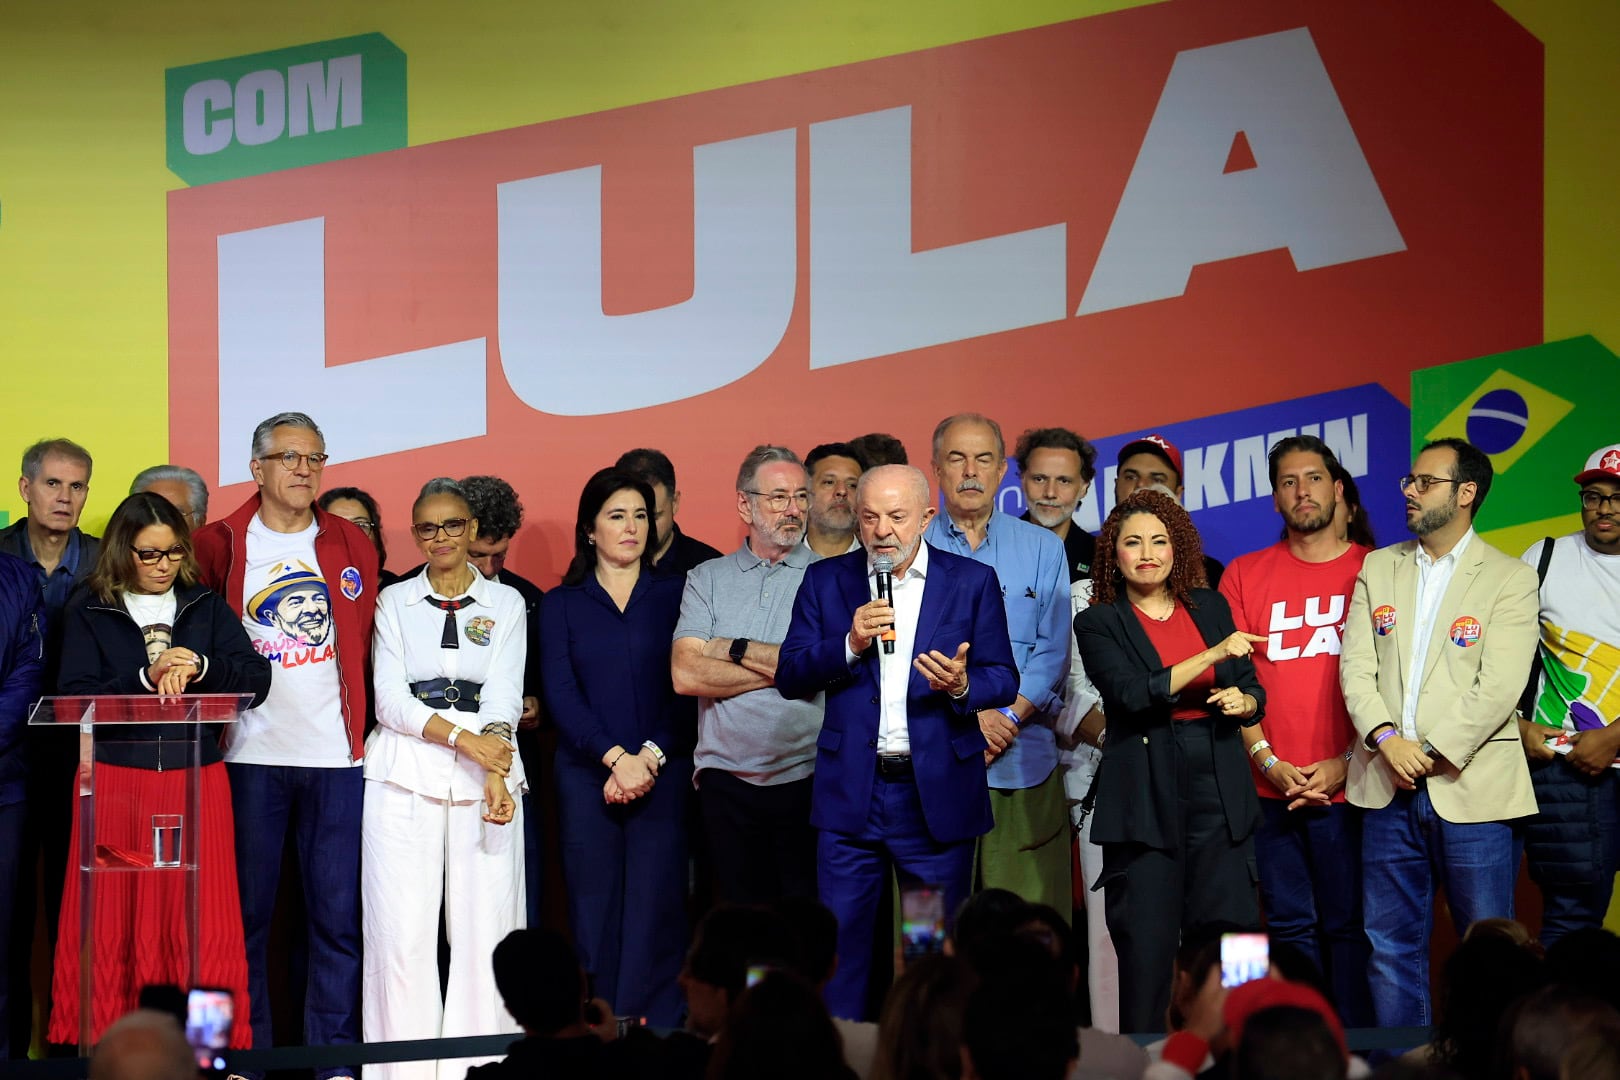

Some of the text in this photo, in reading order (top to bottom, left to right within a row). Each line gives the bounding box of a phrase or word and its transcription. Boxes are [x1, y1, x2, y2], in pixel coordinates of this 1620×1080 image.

[183, 53, 363, 156] COM
[217, 26, 1407, 486] LULA
[1269, 594, 1345, 632] LU
[251, 632, 309, 654] SAÚDE
[1267, 626, 1343, 662] LA
